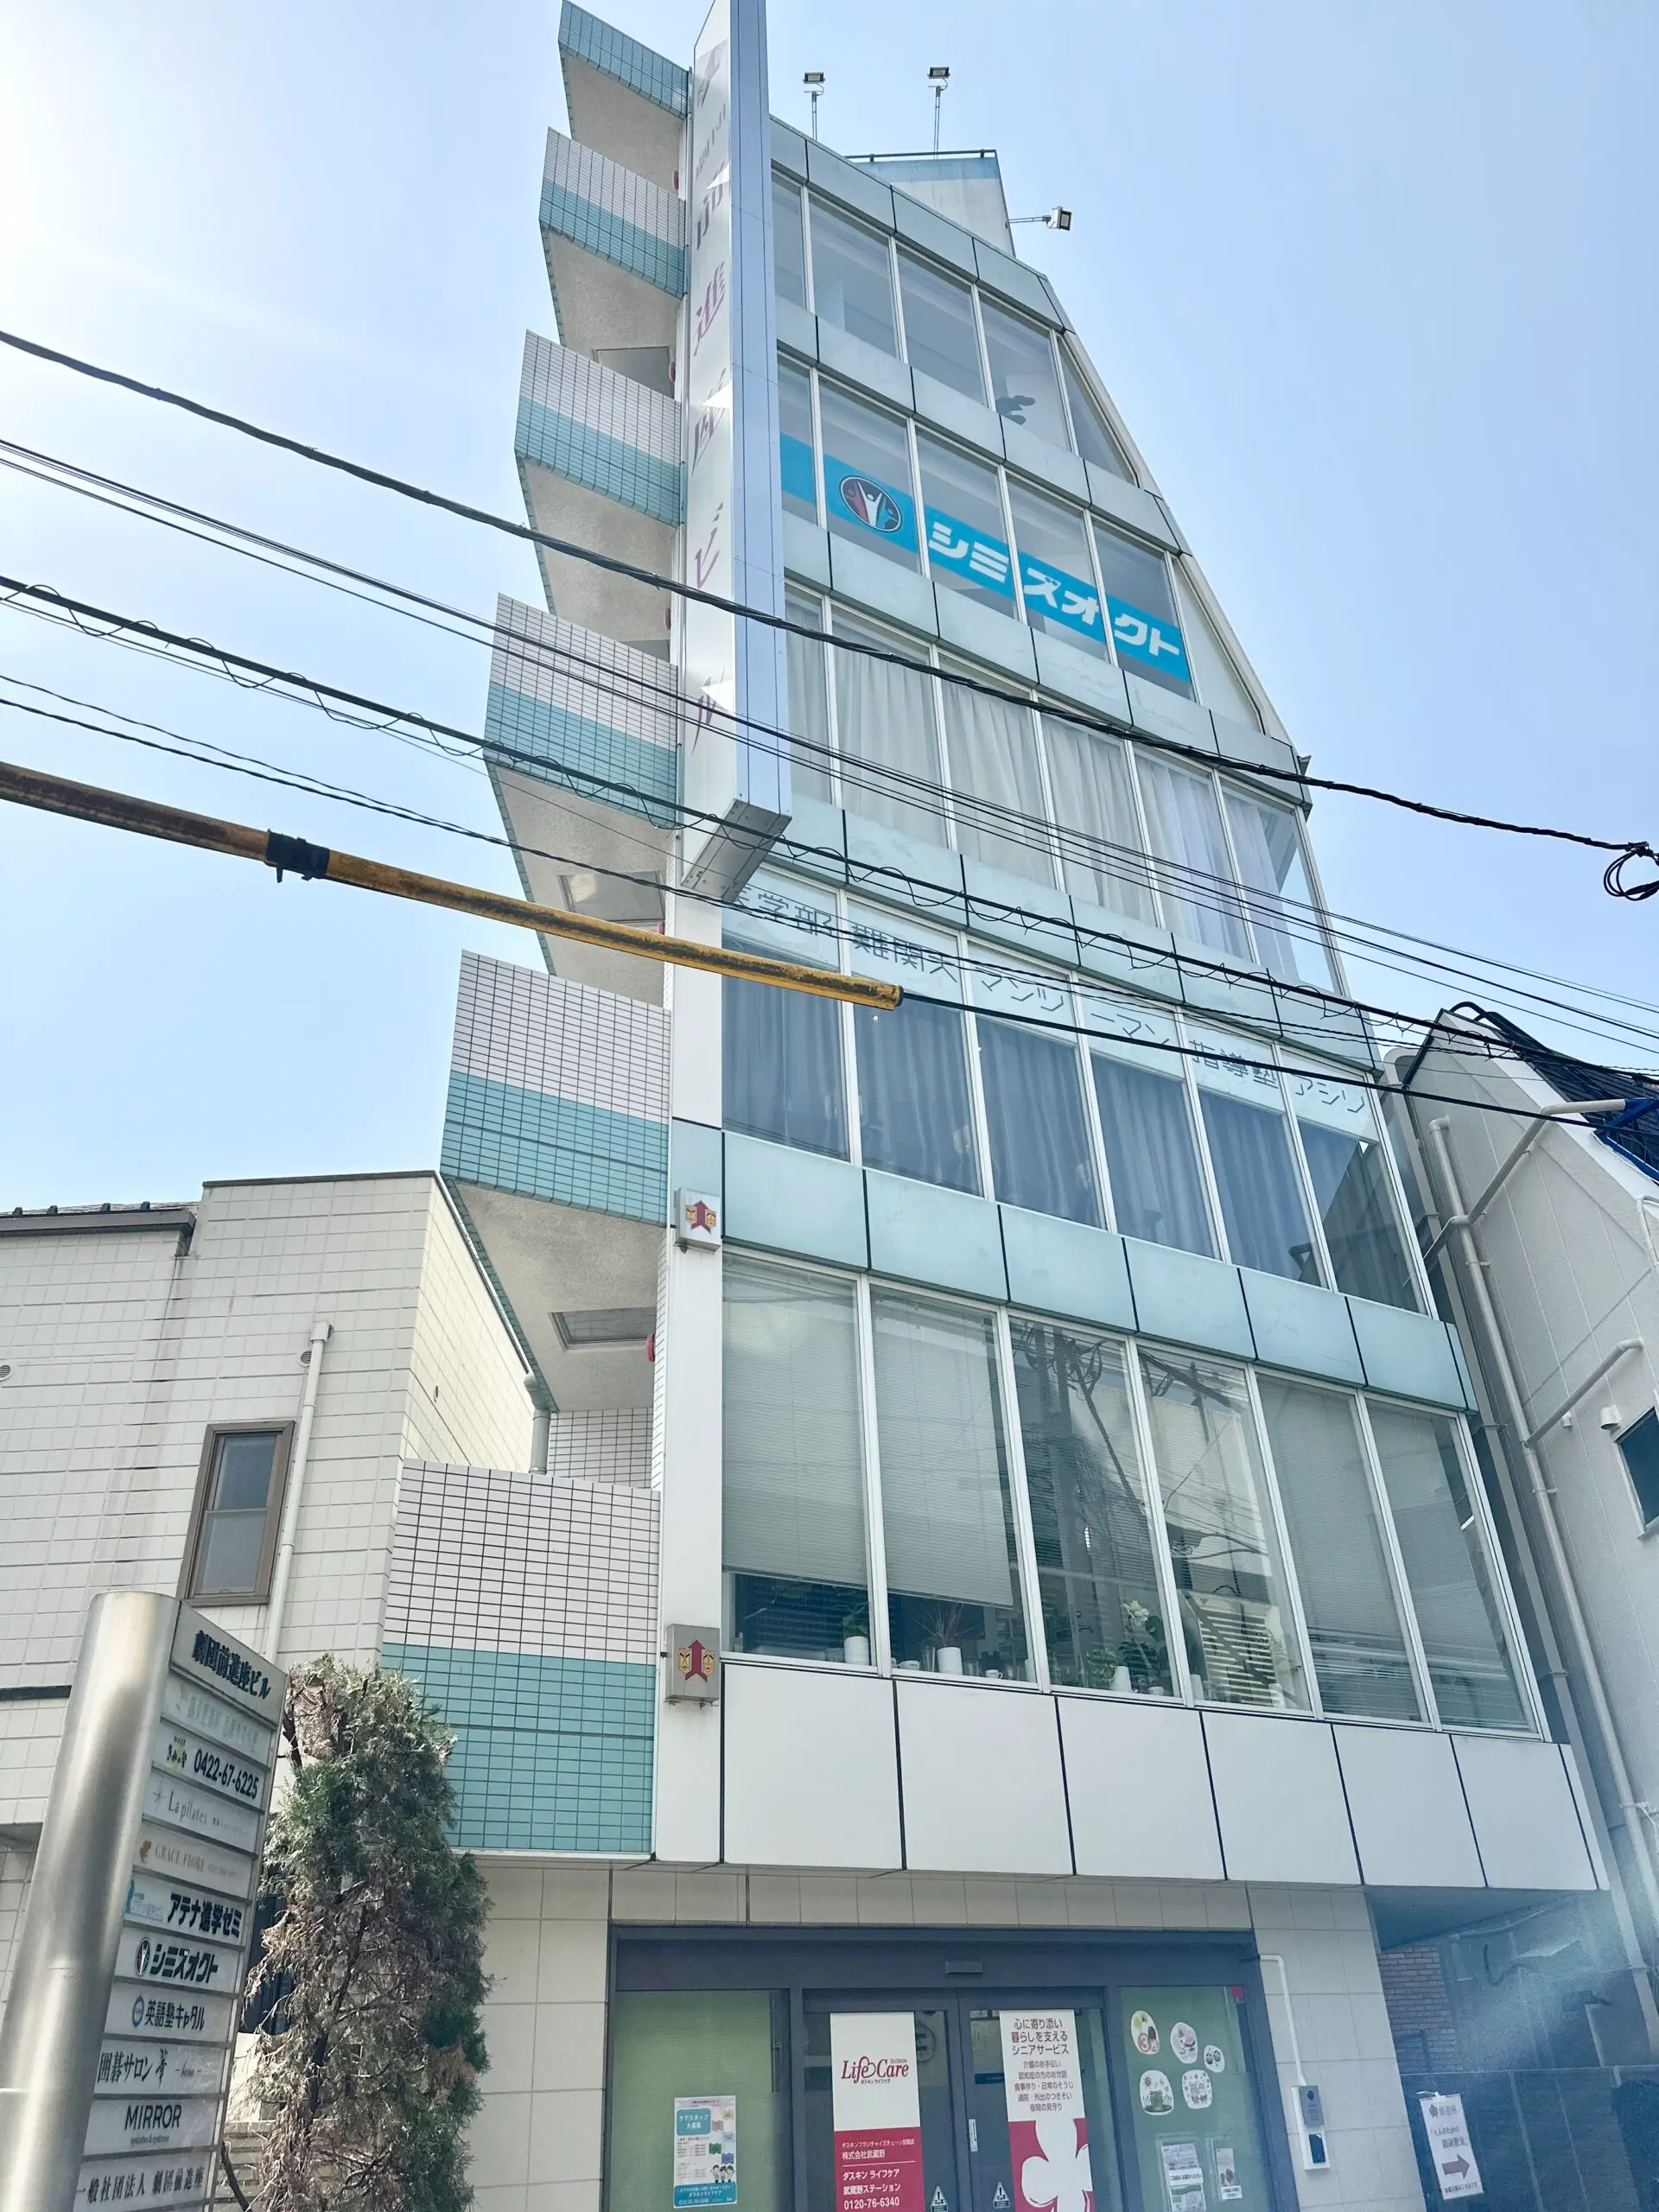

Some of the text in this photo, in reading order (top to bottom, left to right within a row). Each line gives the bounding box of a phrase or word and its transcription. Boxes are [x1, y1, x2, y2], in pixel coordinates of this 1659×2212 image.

[928, 520, 1180, 657] シミズオクト
[192, 1630, 272, 1700] 劇団前進座ビル
[194, 1748, 259, 1799] 0422-67-6225
[168, 1790, 207, 1825] La pilates
[156, 1844, 181, 1865] GRACE
[168, 1892, 242, 1938] アテナ進学ゼミ
[149, 1943, 219, 1983] シミズオクト
[144, 1999, 205, 2031] 英語塾キャタル
[1014, 2018, 1063, 2030] 心に寄り添い
[1011, 2031, 1068, 2043] 暮らしを支える
[1012, 2044, 1069, 2056] シニアサービス
[97, 2050, 154, 2084] 囲碁サロン
[841, 2056, 909, 2083] Life Care
[1018, 2070, 1067, 2080] 認知症の方のお世話
[1023, 2060, 1061, 2069] 介護のお手伝い
[124, 2104, 182, 2130] MIRROR
[1030, 2103, 1062, 2112] 夜間の見守り
[842, 2149, 886, 2160] 株式会社武蔵野
[78, 2166, 205, 2204] 一般社団法人 劇団前進座
[842, 2169, 900, 2181] ダスキン ライフケア
[843, 2183, 901, 2196] 武蔵野ステーション
[843, 2197, 900, 2210] 0120-76-6340
